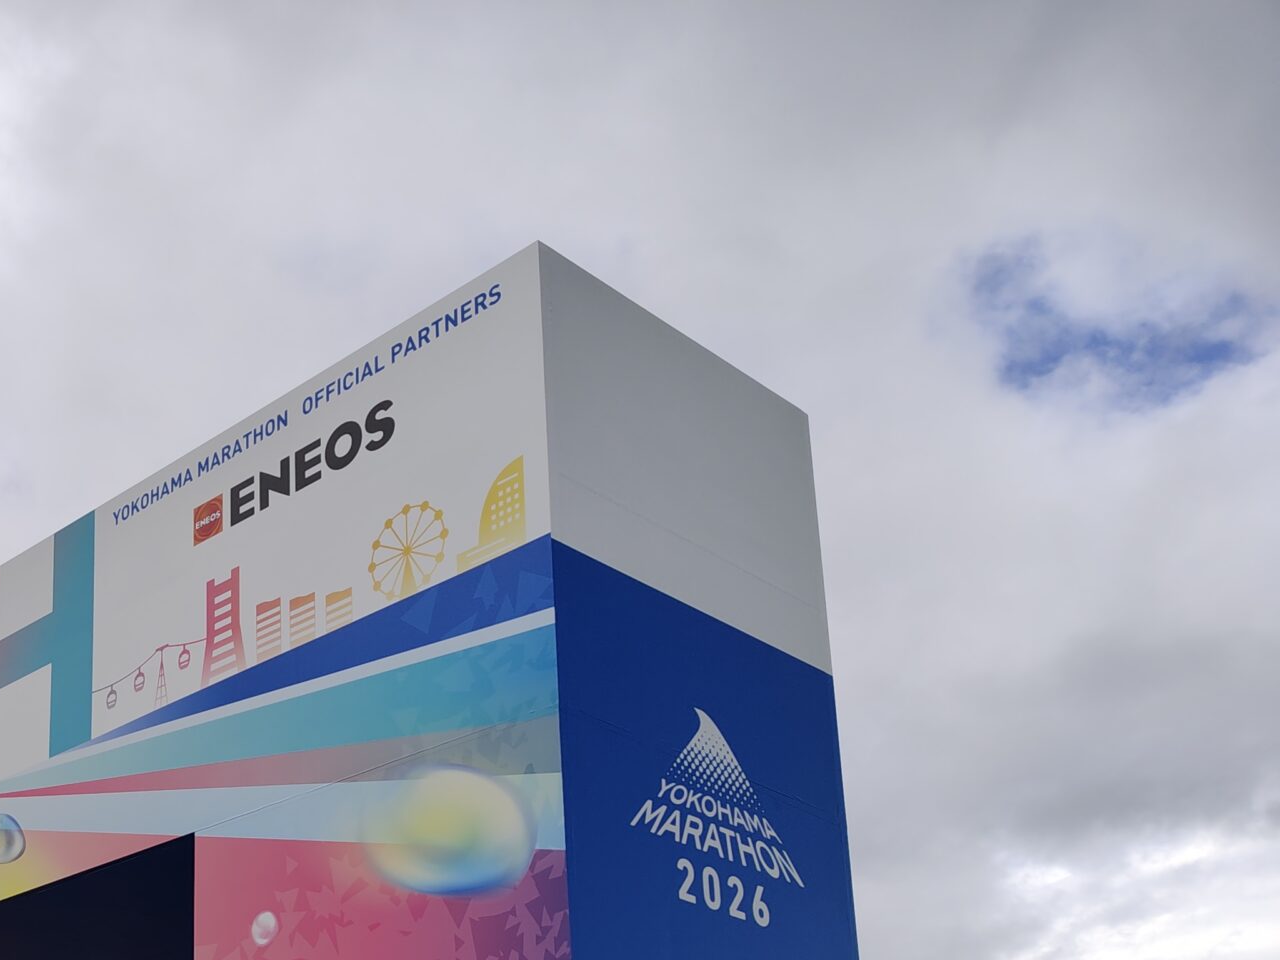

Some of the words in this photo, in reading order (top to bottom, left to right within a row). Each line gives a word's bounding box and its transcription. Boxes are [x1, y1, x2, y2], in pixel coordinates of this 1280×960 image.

[112, 468, 194, 526] YOKOHAMA
[197, 409, 288, 478] MARATHON
[302, 356, 385, 415] OFFICIAL
[390, 283, 502, 364] PARTNERS
[230, 399, 396, 527] ENEOS
[195, 511, 221, 530] ENEOS
[630, 800, 805, 888] MARATHON
[657, 778, 783, 844] YOKOHAMA
[676, 858, 771, 928] 2026
